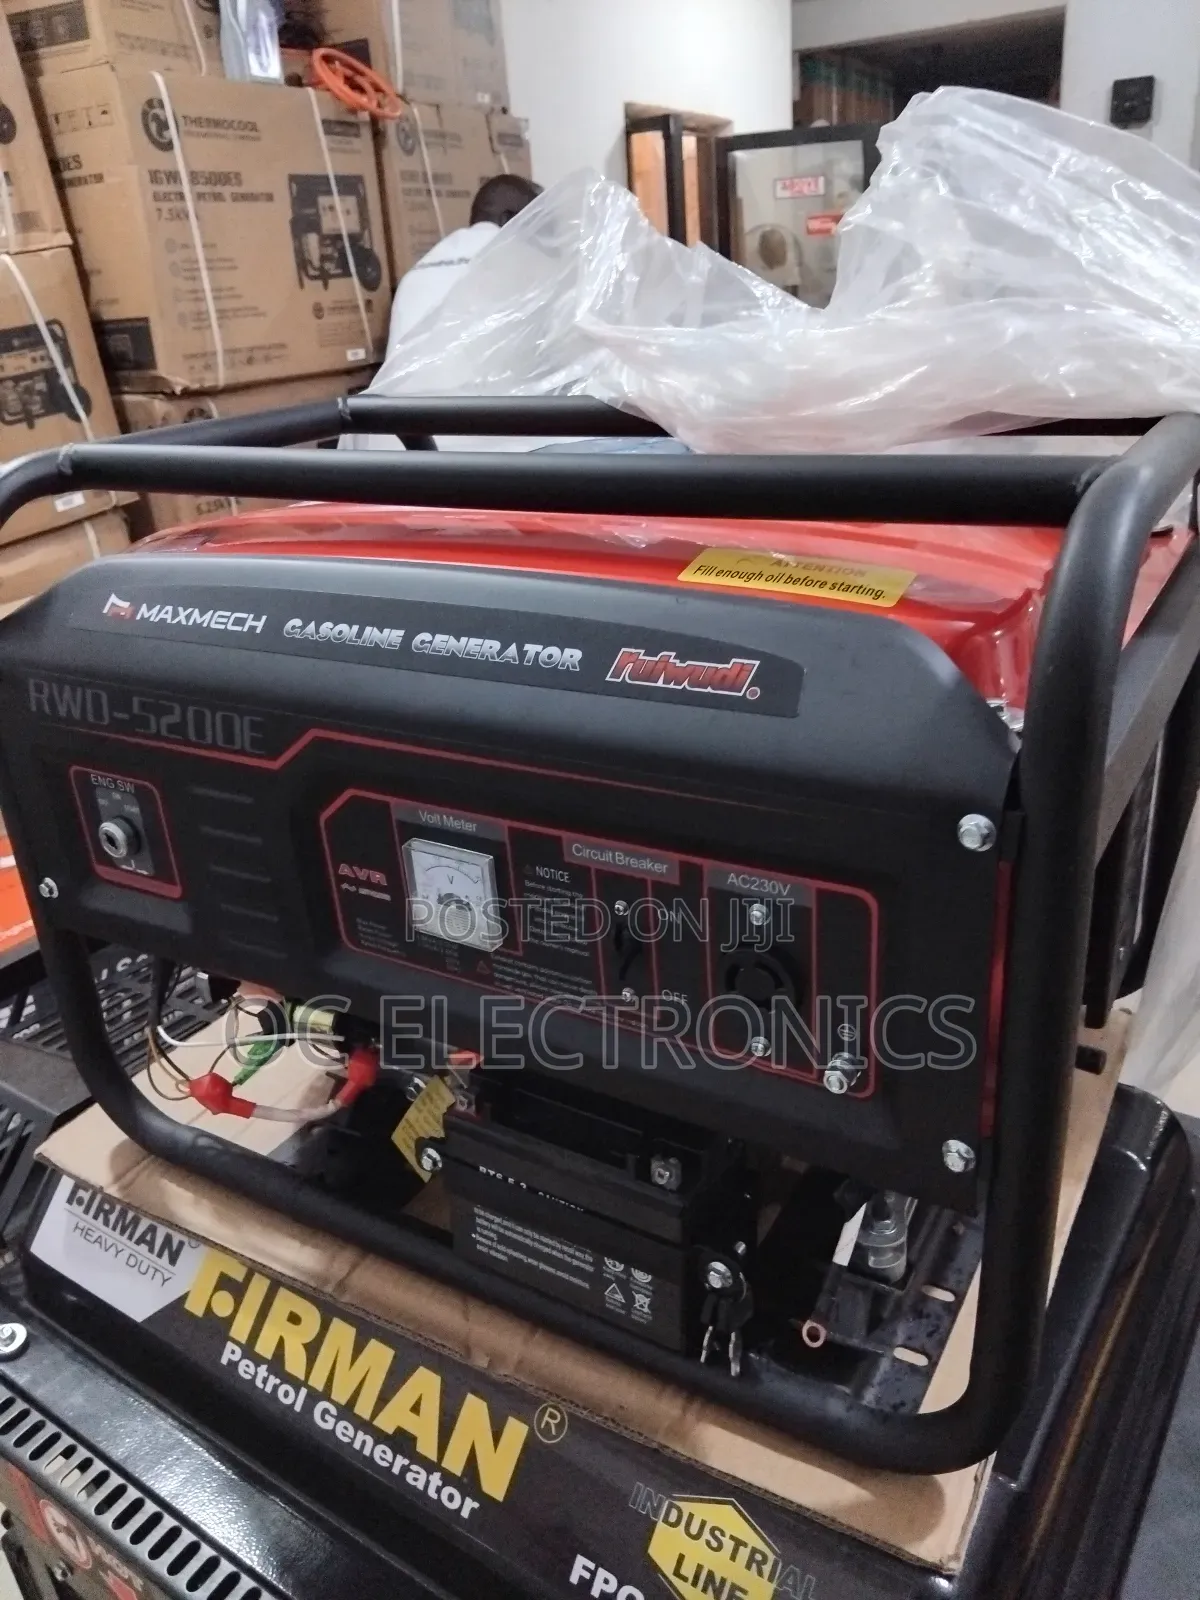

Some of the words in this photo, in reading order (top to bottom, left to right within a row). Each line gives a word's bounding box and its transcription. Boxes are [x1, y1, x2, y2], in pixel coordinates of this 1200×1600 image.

[693, 564, 717, 578] Fill
[716, 567, 763, 583] enough
[764, 570, 784, 583] oil
[783, 573, 827, 590] before
[829, 580, 886, 600] starting.
[136, 602, 267, 633] MAXMECH
[283, 618, 405, 650] GASOLINE
[411, 632, 583, 672] GENERATOR
[90, 773, 115, 789] ENG
[116, 779, 135, 794] SW
[418, 809, 443, 827] Volt
[444, 812, 478, 833] Meter
[338, 863, 388, 886] AVR
[535, 866, 571, 884] NOTICE
[572, 842, 613, 864] Circuit
[614, 850, 669, 875] Breaker
[726, 872, 792, 896] AC230V
[657, 907, 682, 924] ON
[661, 988, 688, 1004] OFF
[66, 1181, 187, 1268] FIRMAN
[72, 1221, 125, 1260] HEAVY
[125, 1254, 173, 1288] DUTY
[184, 1251, 530, 1503] FIRMAN
[220, 1340, 308, 1413] Petrol
[313, 1399, 480, 1520] Generator
[628, 1481, 818, 1600] INDUSTRIAL
